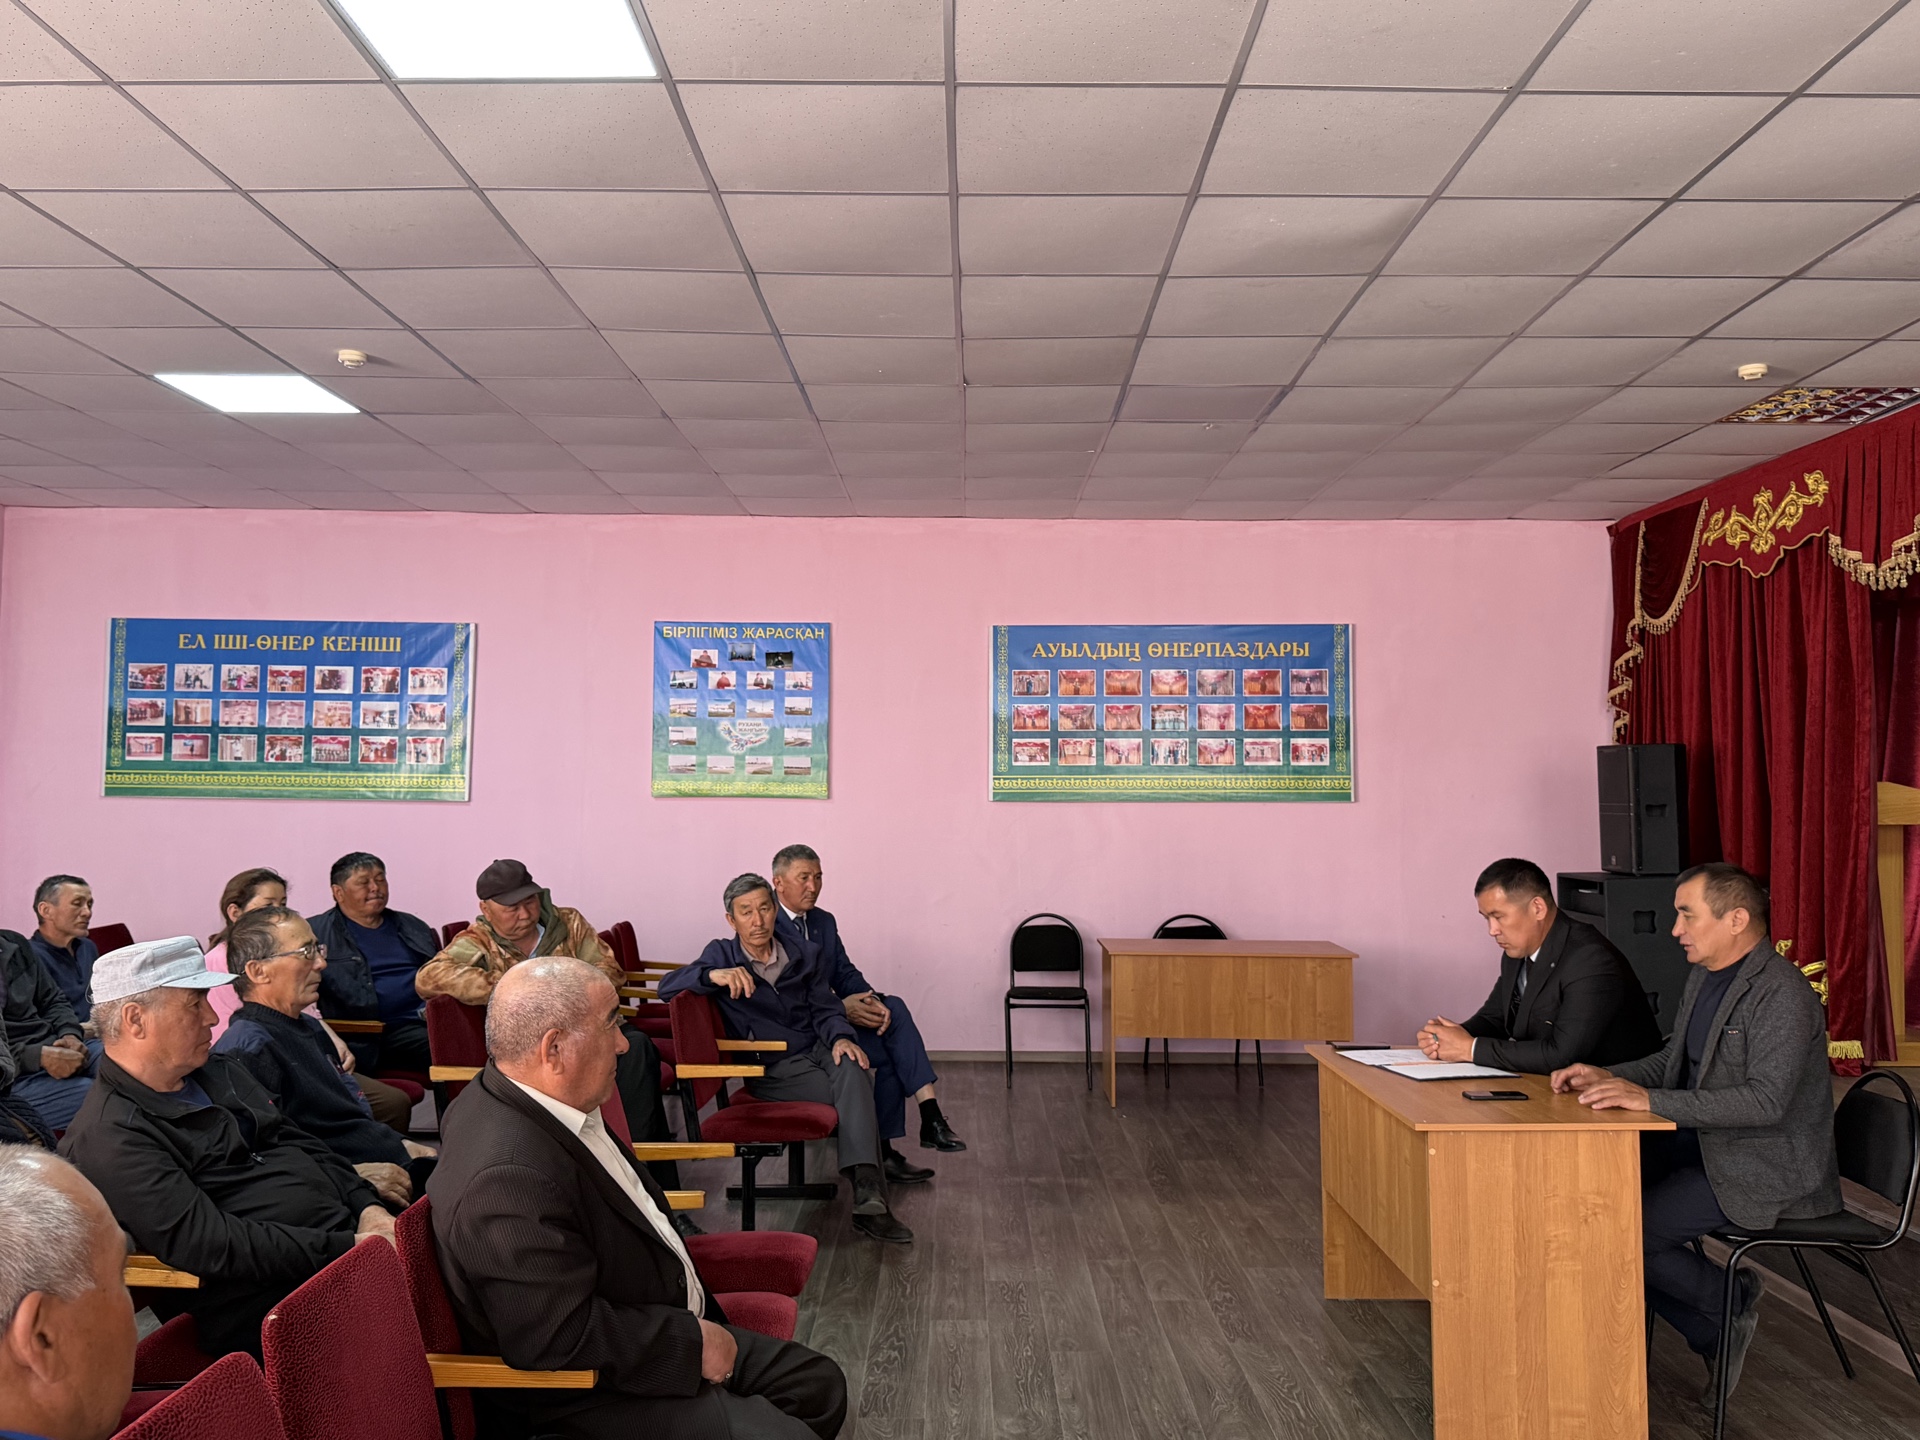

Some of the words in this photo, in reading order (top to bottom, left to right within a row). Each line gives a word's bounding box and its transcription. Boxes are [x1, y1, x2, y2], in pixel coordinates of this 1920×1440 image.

[178, 633, 206, 649] ЕЛ
[322, 636, 402, 652] КЕНІШІ
[662, 626, 738, 638] БІРЛІГІМІЗ
[742, 627, 825, 641] ЖАРАСҚАН
[1031, 642, 1141, 662] АУЫЛДЫҢ
[1147, 642, 1311, 661] ӨНЕРПАЗДАРЫ
